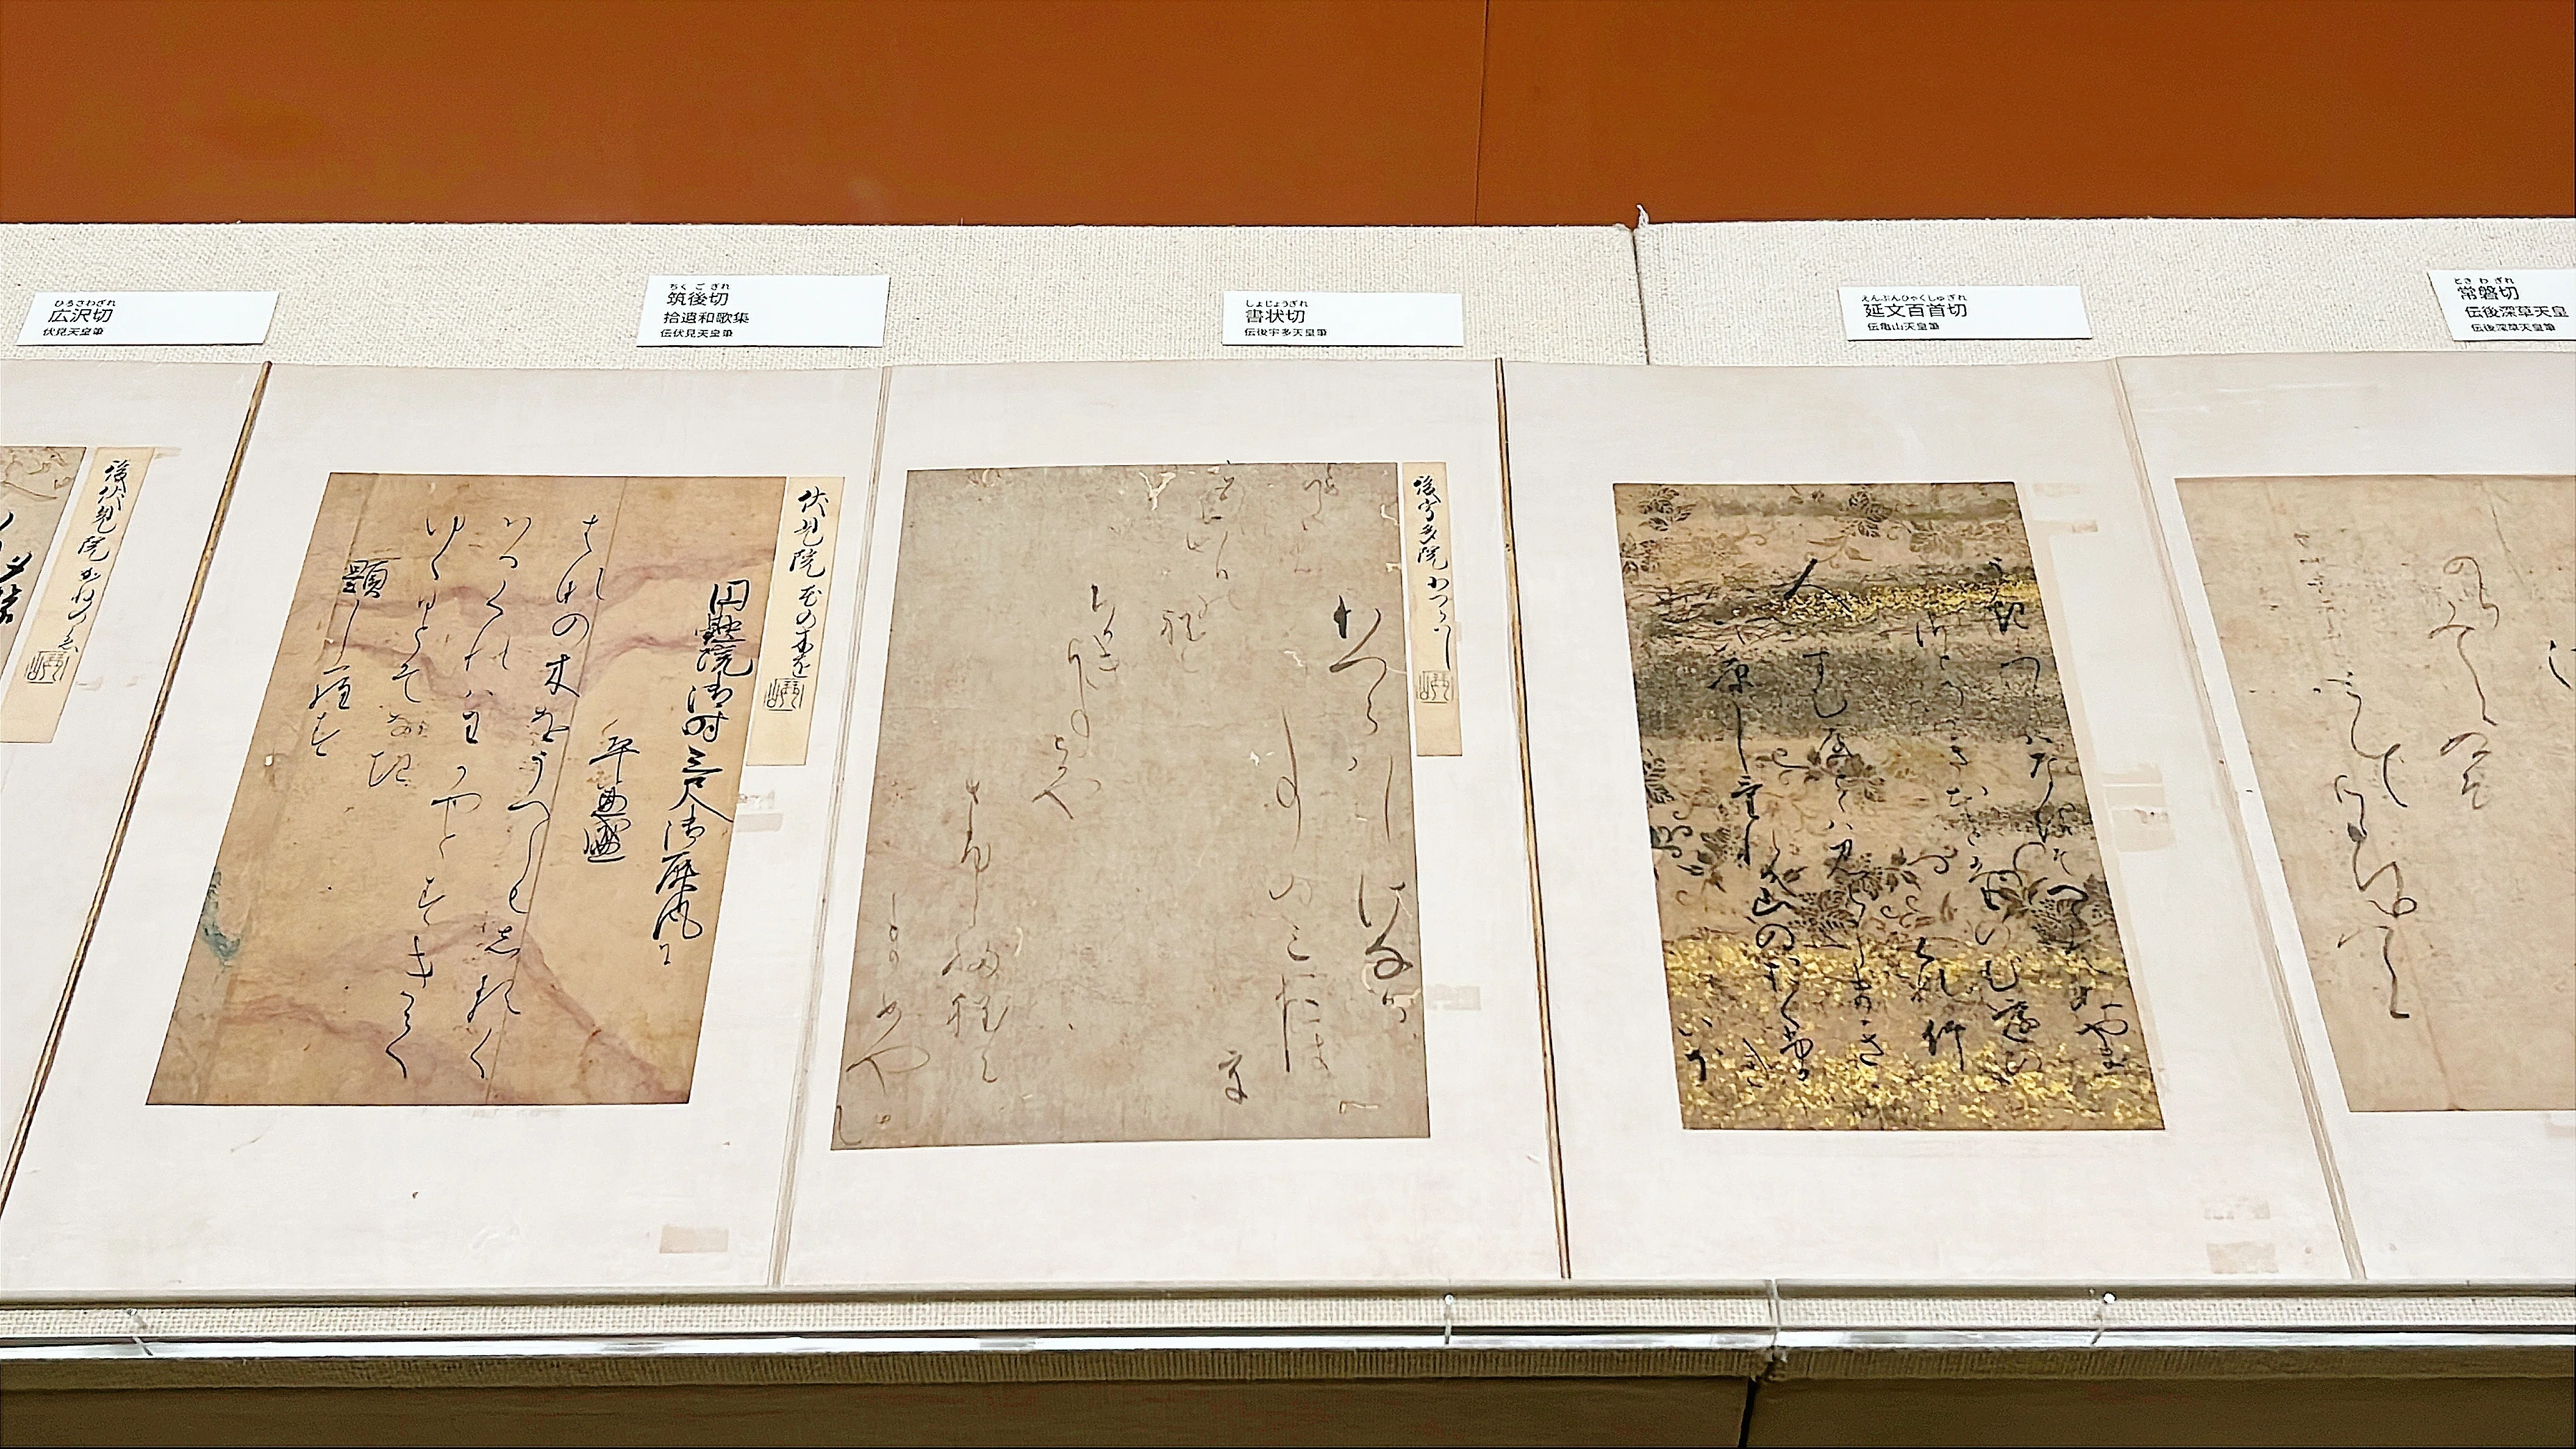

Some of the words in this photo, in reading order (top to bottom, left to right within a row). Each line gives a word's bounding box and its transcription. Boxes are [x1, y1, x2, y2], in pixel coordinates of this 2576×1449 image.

[666, 291, 729, 306] 筑後切
[48, 308, 114, 323] 広沢切
[663, 311, 750, 324] 拾遺和歌集
[1245, 309, 1306, 324] 書状切
[1863, 303, 1968, 318] 延文百首切
